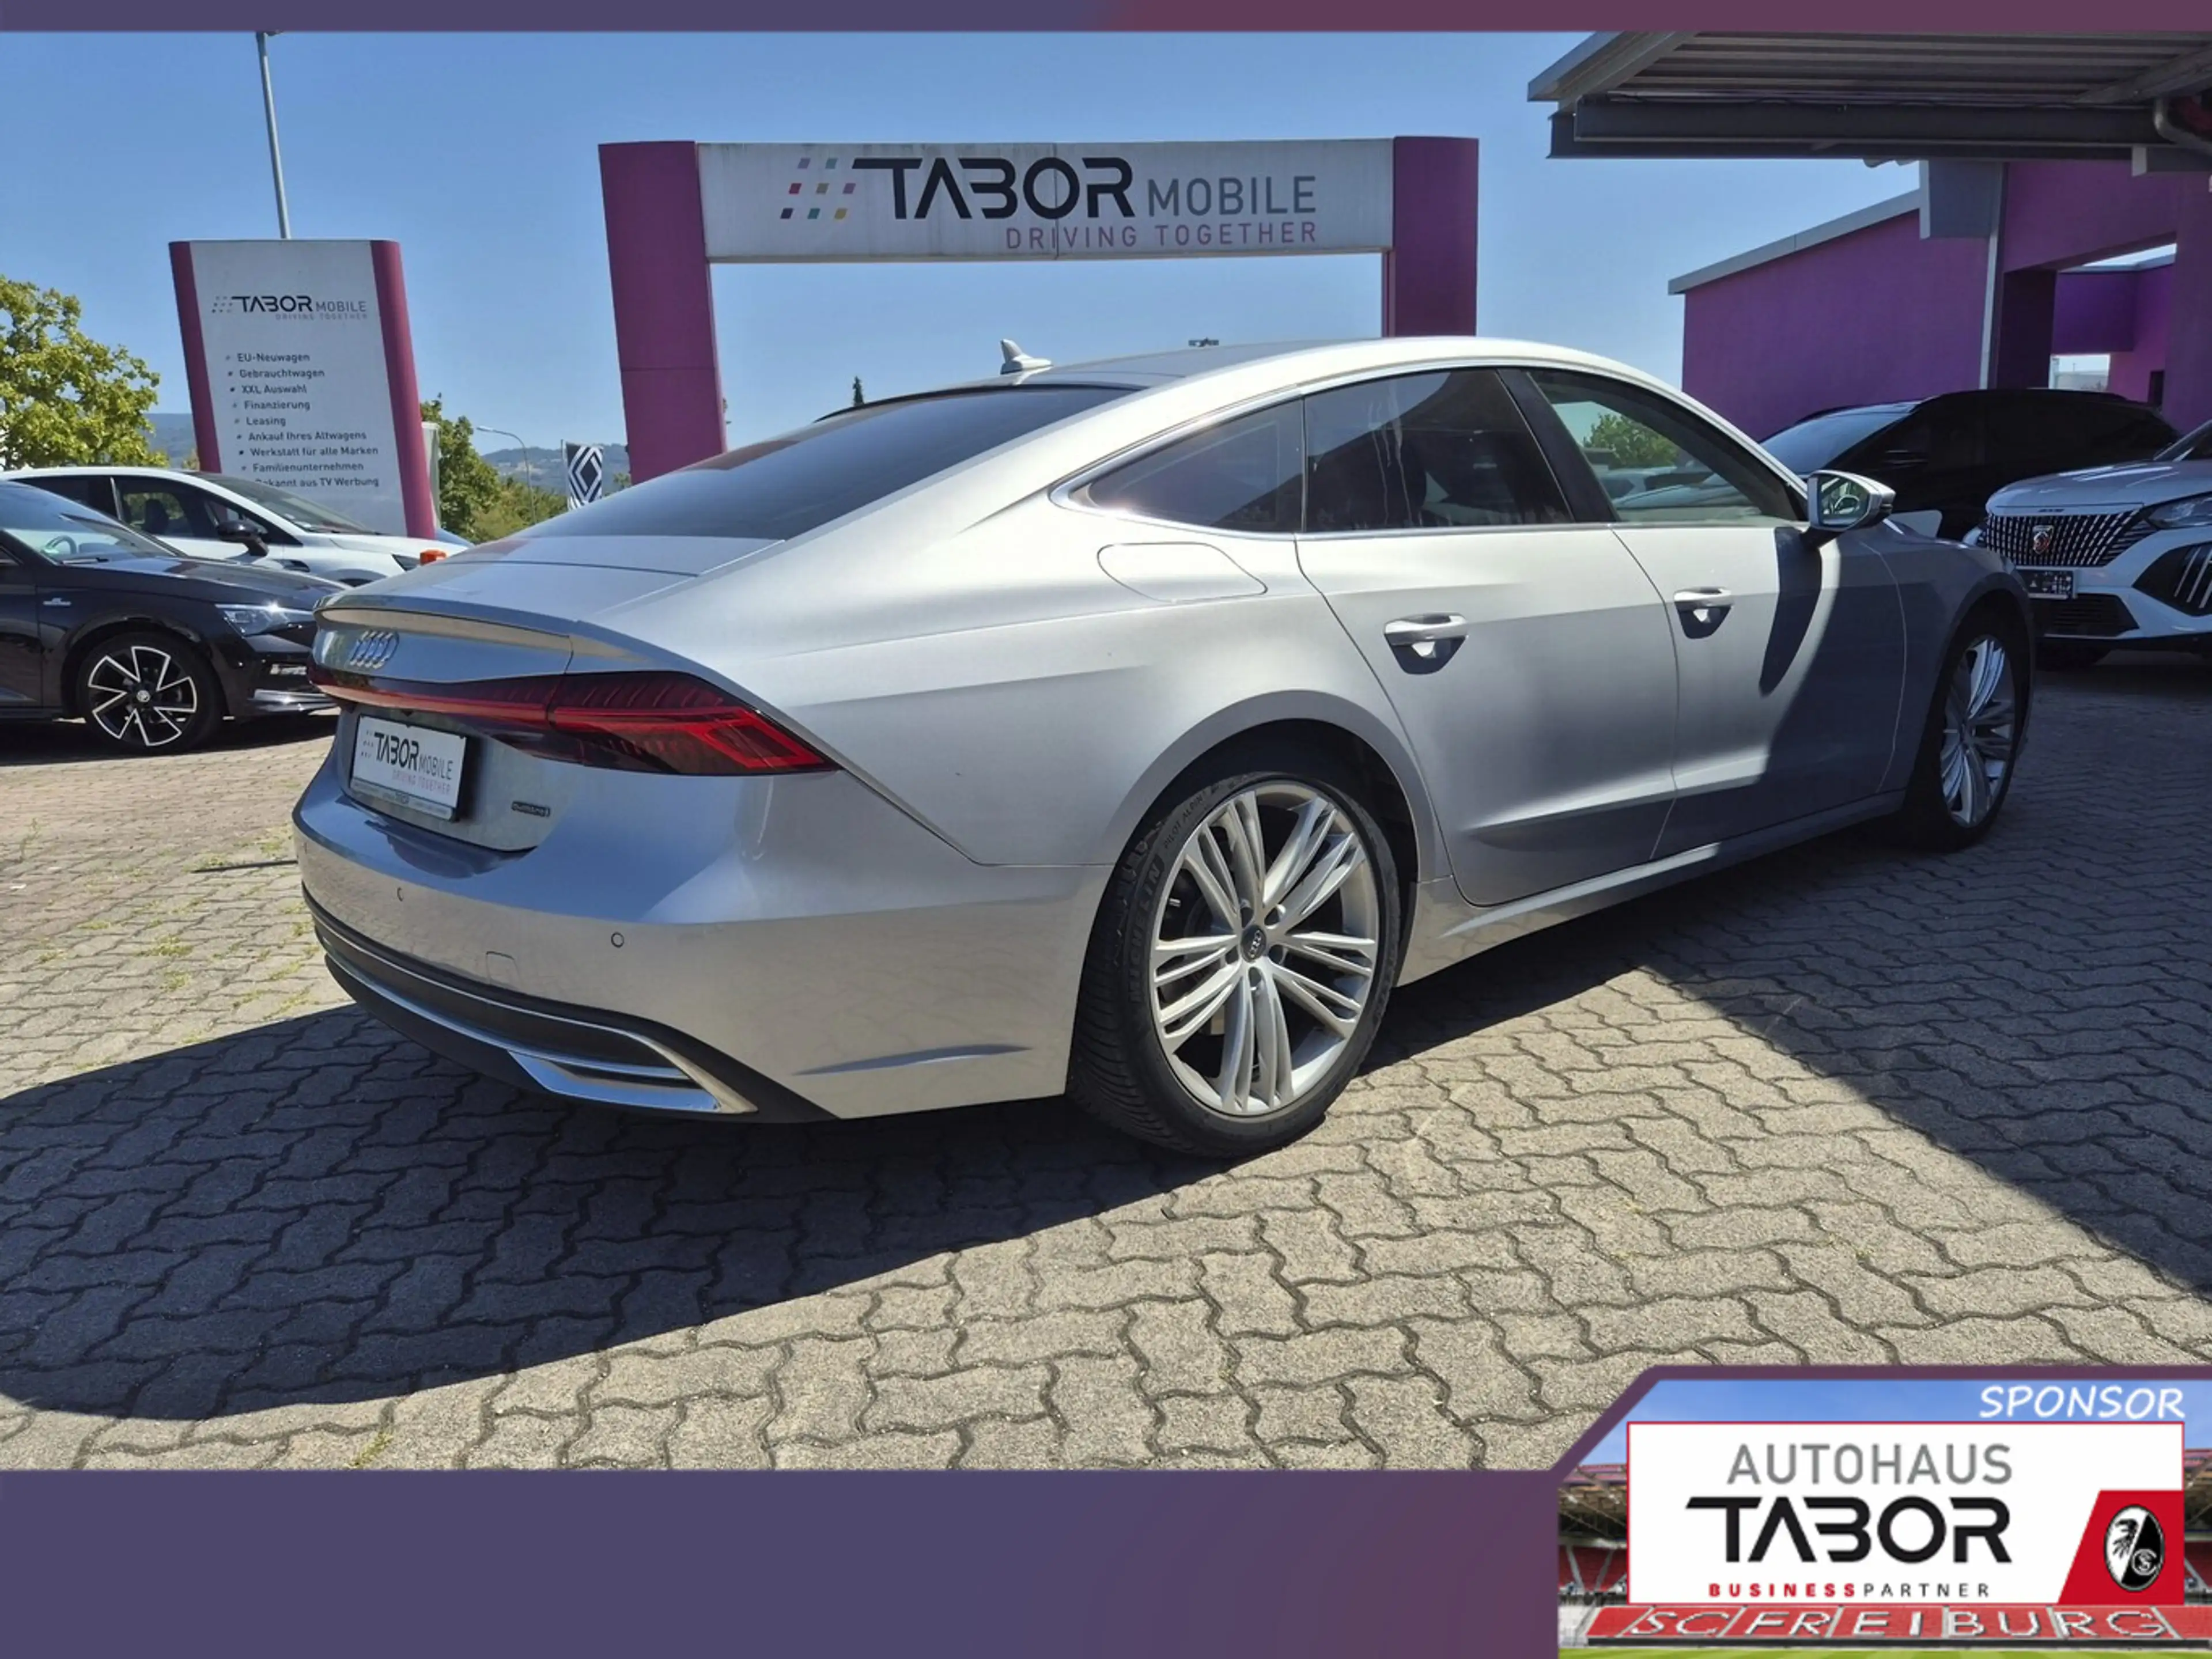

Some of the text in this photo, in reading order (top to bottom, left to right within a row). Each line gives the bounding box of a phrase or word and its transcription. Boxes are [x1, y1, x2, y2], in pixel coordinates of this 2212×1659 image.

[852, 157, 1317, 219] TABOR MOBILE
[1007, 221, 1317, 249] DRIVING TOGETHER
[231, 296, 366, 312] TABOR MOBILE
[237, 353, 311, 363] EU-Neuwagen
[240, 369, 325, 380] Gebrauchtwagen
[241, 384, 307, 394] XXL Auswahl
[244, 400, 311, 411] Finanzierung
[246, 416, 286, 427] Leasing
[248, 431, 367, 442] Ankauf Ihres Altwagens
[249, 446, 378, 457] Werkstatt für alle Marken
[253, 463, 364, 472] Familienunternehmen
[319, 478, 332, 486] TV
[334, 478, 379, 487] Werbung
[374, 732, 453, 781] TABOR MOBILE
